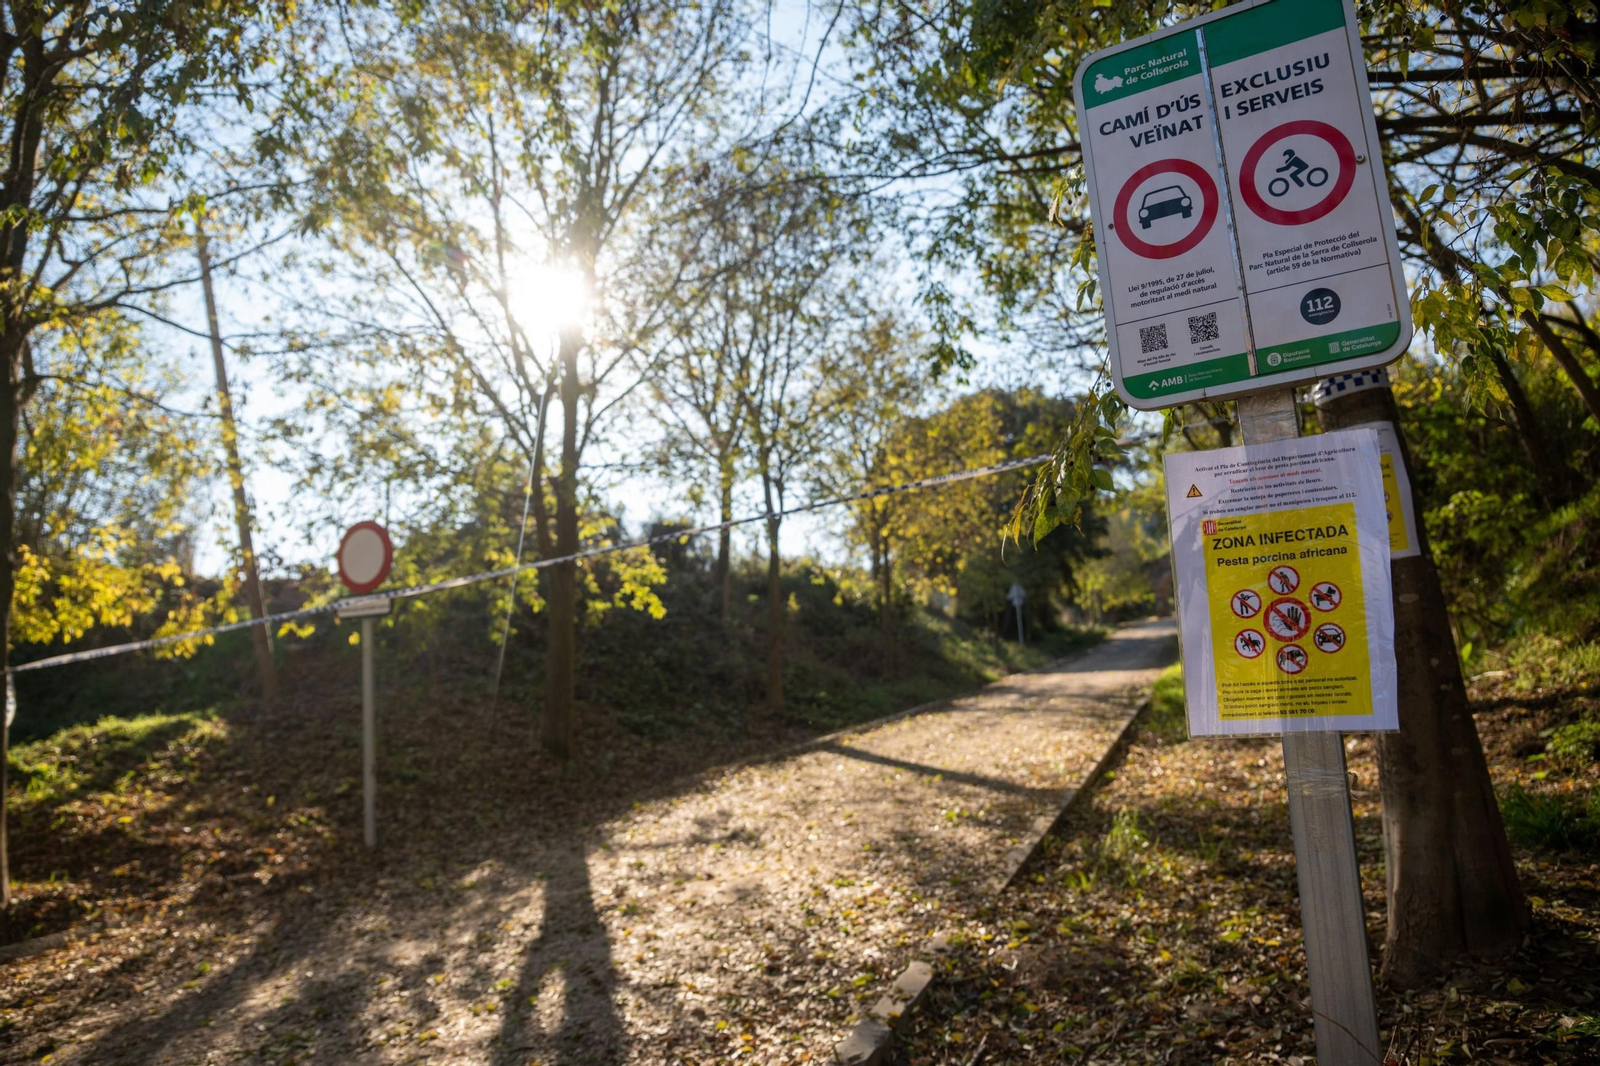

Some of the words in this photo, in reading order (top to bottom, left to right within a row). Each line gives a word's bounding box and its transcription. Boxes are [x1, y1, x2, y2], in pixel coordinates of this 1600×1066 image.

[1124, 64, 1146, 76] Parc
[1148, 48, 1187, 68] Natural
[1126, 76, 1138, 85] de
[1140, 60, 1189, 80] Collserola
[1220, 52, 1330, 98] EXCLUSIU
[1224, 106, 1231, 120] I
[1236, 78, 1324, 116] SERVEIS
[1100, 106, 1150, 136] CAMÍ
[1130, 115, 1203, 148] VEÏNAT
[1249, 262, 1264, 271] Parc
[1265, 256, 1291, 268] Natural
[1310, 248, 1329, 257] Serra
[1342, 236, 1378, 250] Collserola
[1262, 250, 1273, 259] Pla
[1274, 244, 1302, 257] Especial
[1314, 234, 1347, 248] Protecció
[1348, 230, 1360, 240] del
[1266, 264, 1291, 276] (article
[1321, 248, 1362, 263] Normativa)
[1128, 284, 1140, 293] Llei
[1141, 280, 1165, 290] 9/1995,
[1196, 266, 1215, 278] juliol,
[1150, 284, 1180, 297] regulació
[1131, 295, 1165, 308] motoritzat
[1174, 288, 1191, 297] medi
[1193, 283, 1217, 294] natural
[1306, 296, 1334, 312] 112
[1283, 349, 1310, 358] Diputació
[1342, 336, 1375, 346] Generalitat
[1351, 340, 1382, 350] Catalunya
[1284, 354, 1311, 363] Barcelona
[1161, 376, 1183, 388] AMB
[1237, 458, 1271, 467] Contingència
[1281, 452, 1316, 462] Departament
[1273, 480, 1297, 488] activitats
[1305, 485, 1338, 494] contenidors.
[1212, 535, 1255, 550] ZONA
[1259, 525, 1349, 546] INFECTADA
[1217, 556, 1248, 567] Pesta
[1252, 552, 1296, 565] porcina
[1300, 546, 1347, 559] africana
